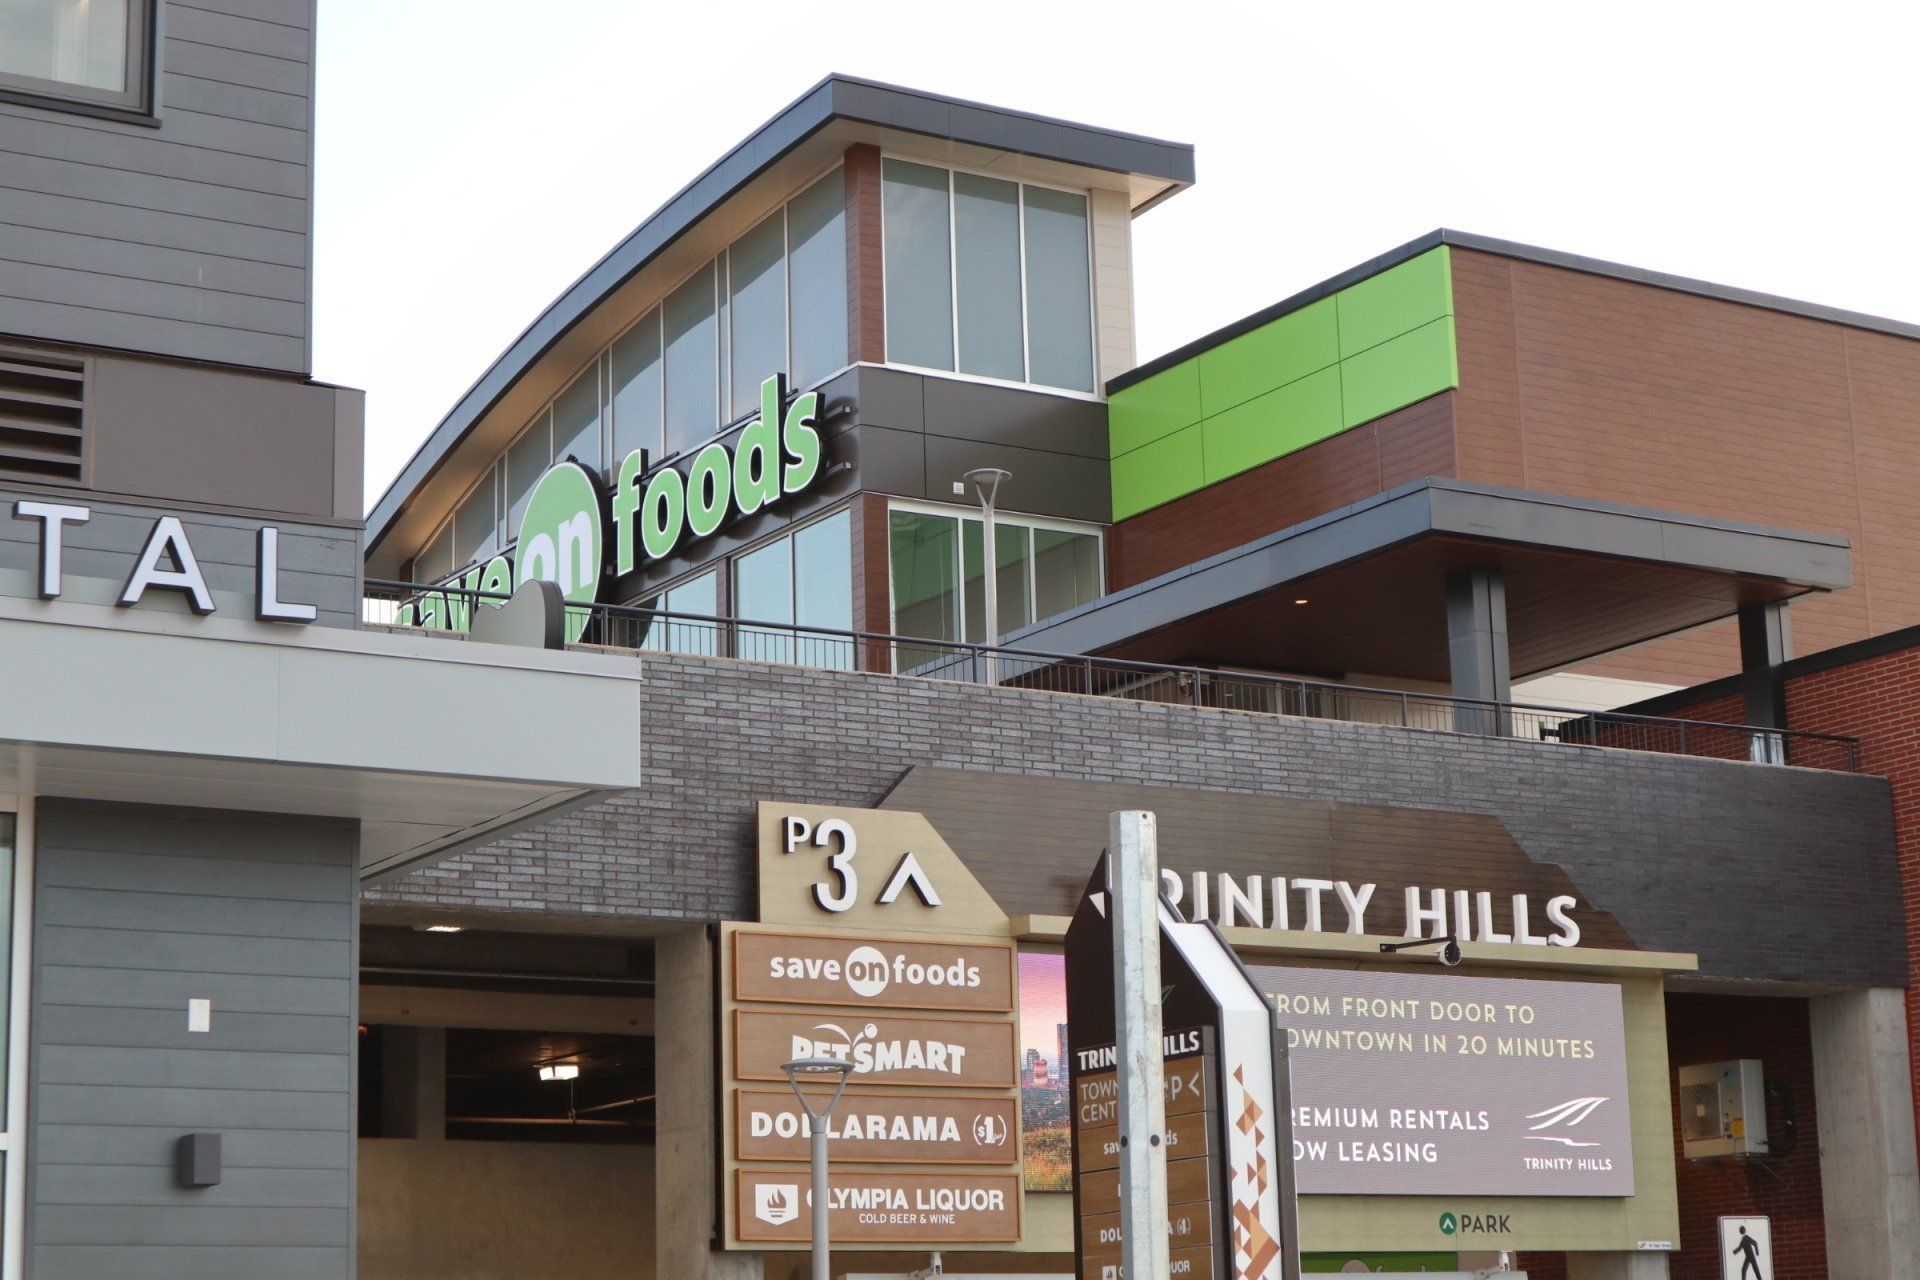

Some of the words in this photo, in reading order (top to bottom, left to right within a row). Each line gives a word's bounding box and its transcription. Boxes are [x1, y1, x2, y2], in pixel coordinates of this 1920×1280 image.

[394, 555, 512, 634] ave
[520, 510, 595, 598] on
[612, 372, 825, 578] foods
[12, 500, 318, 622] TAL
[1160, 867, 1377, 935] RINITY
[1403, 885, 1581, 948] HILLS
[770, 955, 841, 982] save
[848, 958, 887, 983] on
[893, 954, 981, 988] foods
[1342, 996, 1420, 1020] FRONT
[1430, 1001, 1497, 1024] DOOR
[1505, 1004, 1536, 1026] TO
[1163, 1030, 1200, 1056] ILLS
[1288, 1028, 1413, 1054] OWNTOWN
[1424, 1033, 1447, 1054] IN
[1457, 1035, 1487, 1055] 20
[1498, 1037, 1596, 1060] MINUTES
[1390, 1109, 1490, 1131] RENTALS
[1338, 1141, 1438, 1163] LEASING
[1524, 1157, 1573, 1171] TRINITY
[1578, 1158, 1613, 1171] HILLS
[916, 1188, 1005, 1212] LIQUOR
[859, 1213, 887, 1224] COLD
[890, 1213, 917, 1225] BEER
[919, 1214, 927, 1225] &
[930, 1214, 956, 1225] WINE
[1461, 1214, 1512, 1234] PARK
